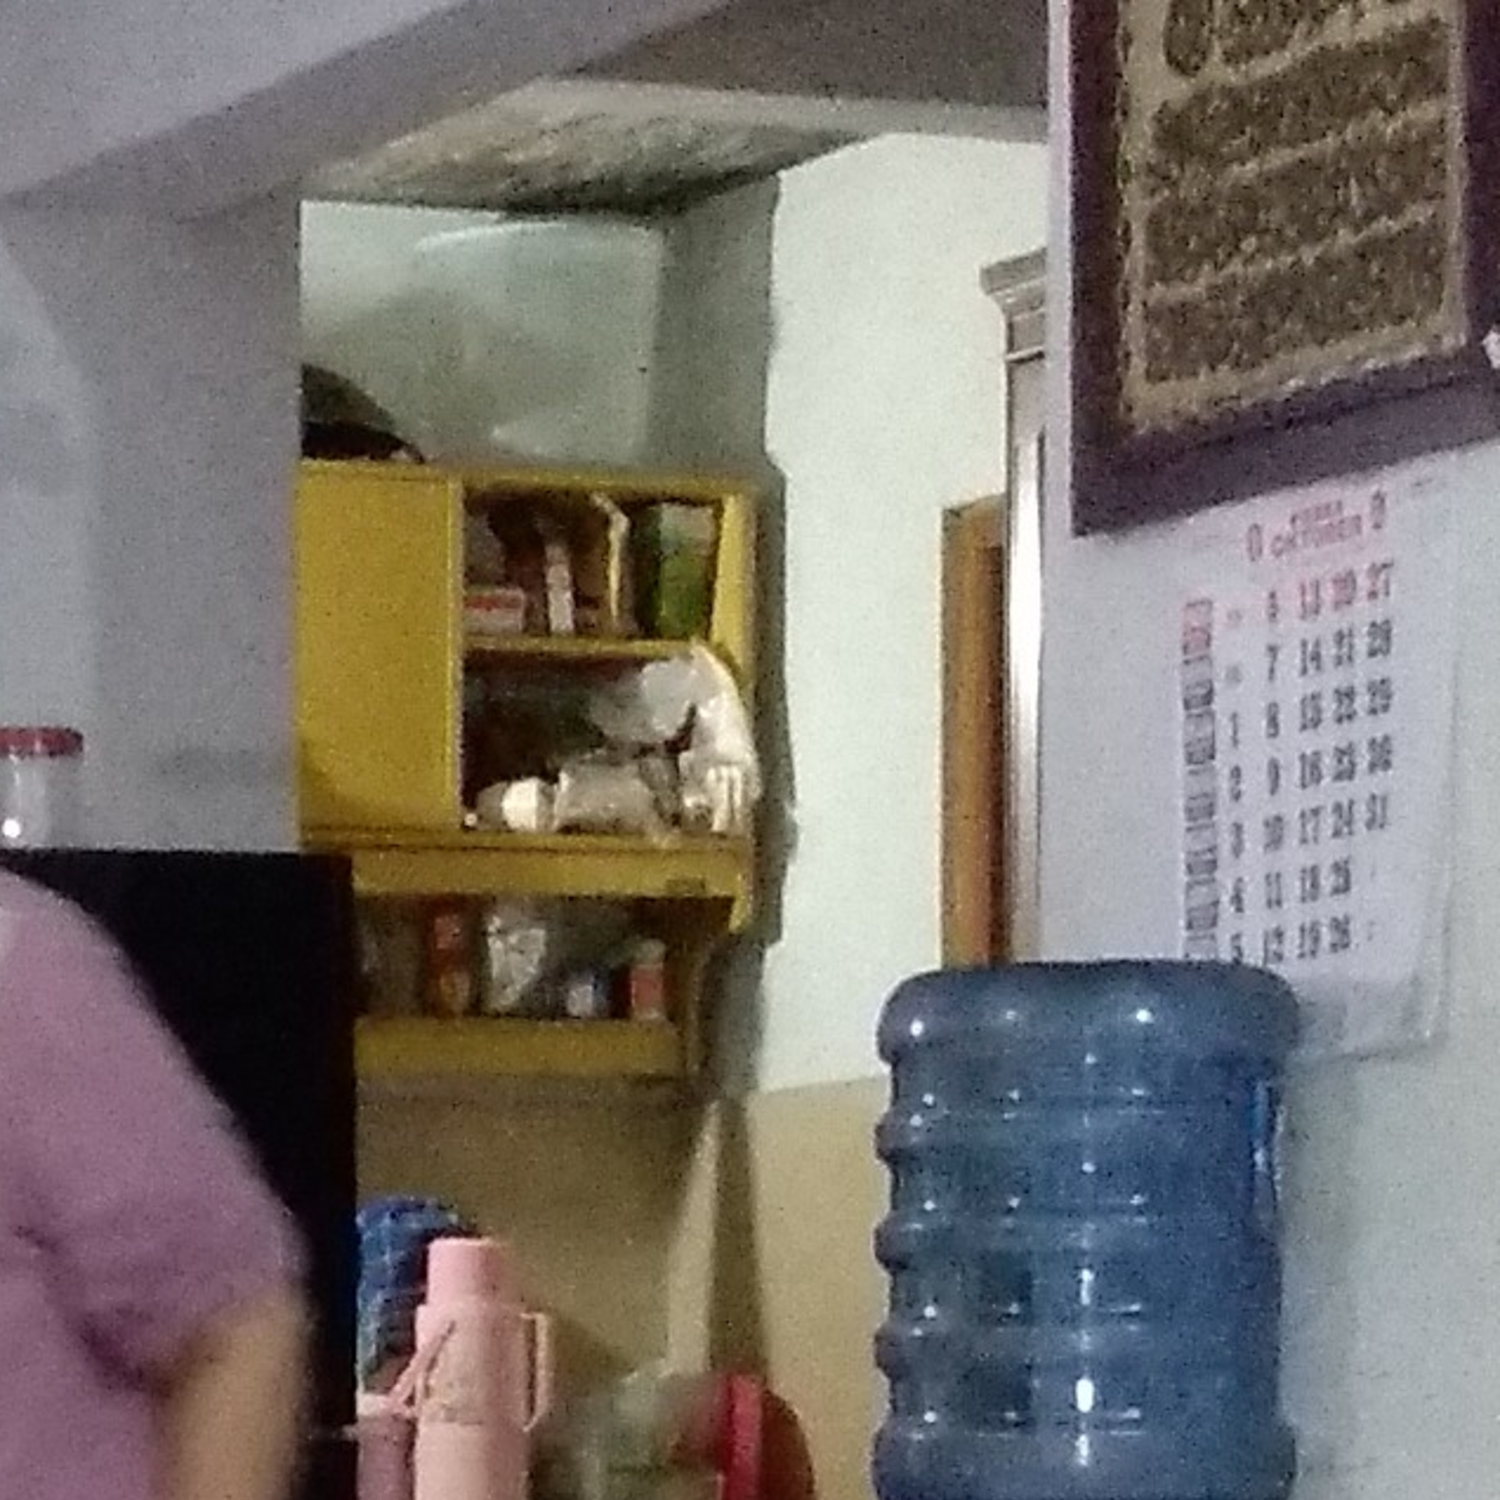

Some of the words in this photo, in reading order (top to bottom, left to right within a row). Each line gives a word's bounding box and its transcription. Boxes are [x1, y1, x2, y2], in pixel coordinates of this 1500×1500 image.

[1366, 561, 1393, 602] 27
[1265, 643, 1280, 683] 7
[1299, 636, 1323, 678] 14
[1332, 625, 1355, 668] 21
[1366, 617, 1393, 659] 28
[1229, 711, 1239, 748] 1
[1265, 700, 1281, 740] 8
[1298, 690, 1323, 732] 15
[1332, 684, 1358, 725] 22
[1366, 676, 1393, 717] 29
[1229, 765, 1242, 803] 2
[1267, 756, 1281, 797] 9
[1298, 750, 1323, 790] 16
[1331, 742, 1357, 782] 23
[1366, 733, 1393, 775] 30
[1263, 814, 1284, 853] 10
[1299, 805, 1325, 846] 17
[1330, 799, 1354, 840] 24
[1365, 793, 1388, 831] 31
[1229, 875, 1245, 914] 4
[1264, 871, 1283, 910] 11
[1299, 864, 1320, 904] 18
[1329, 856, 1352, 897] 25
[1263, 924, 1285, 966] 12
[1297, 919, 1321, 960] 19
[1329, 913, 1351, 955] 26
